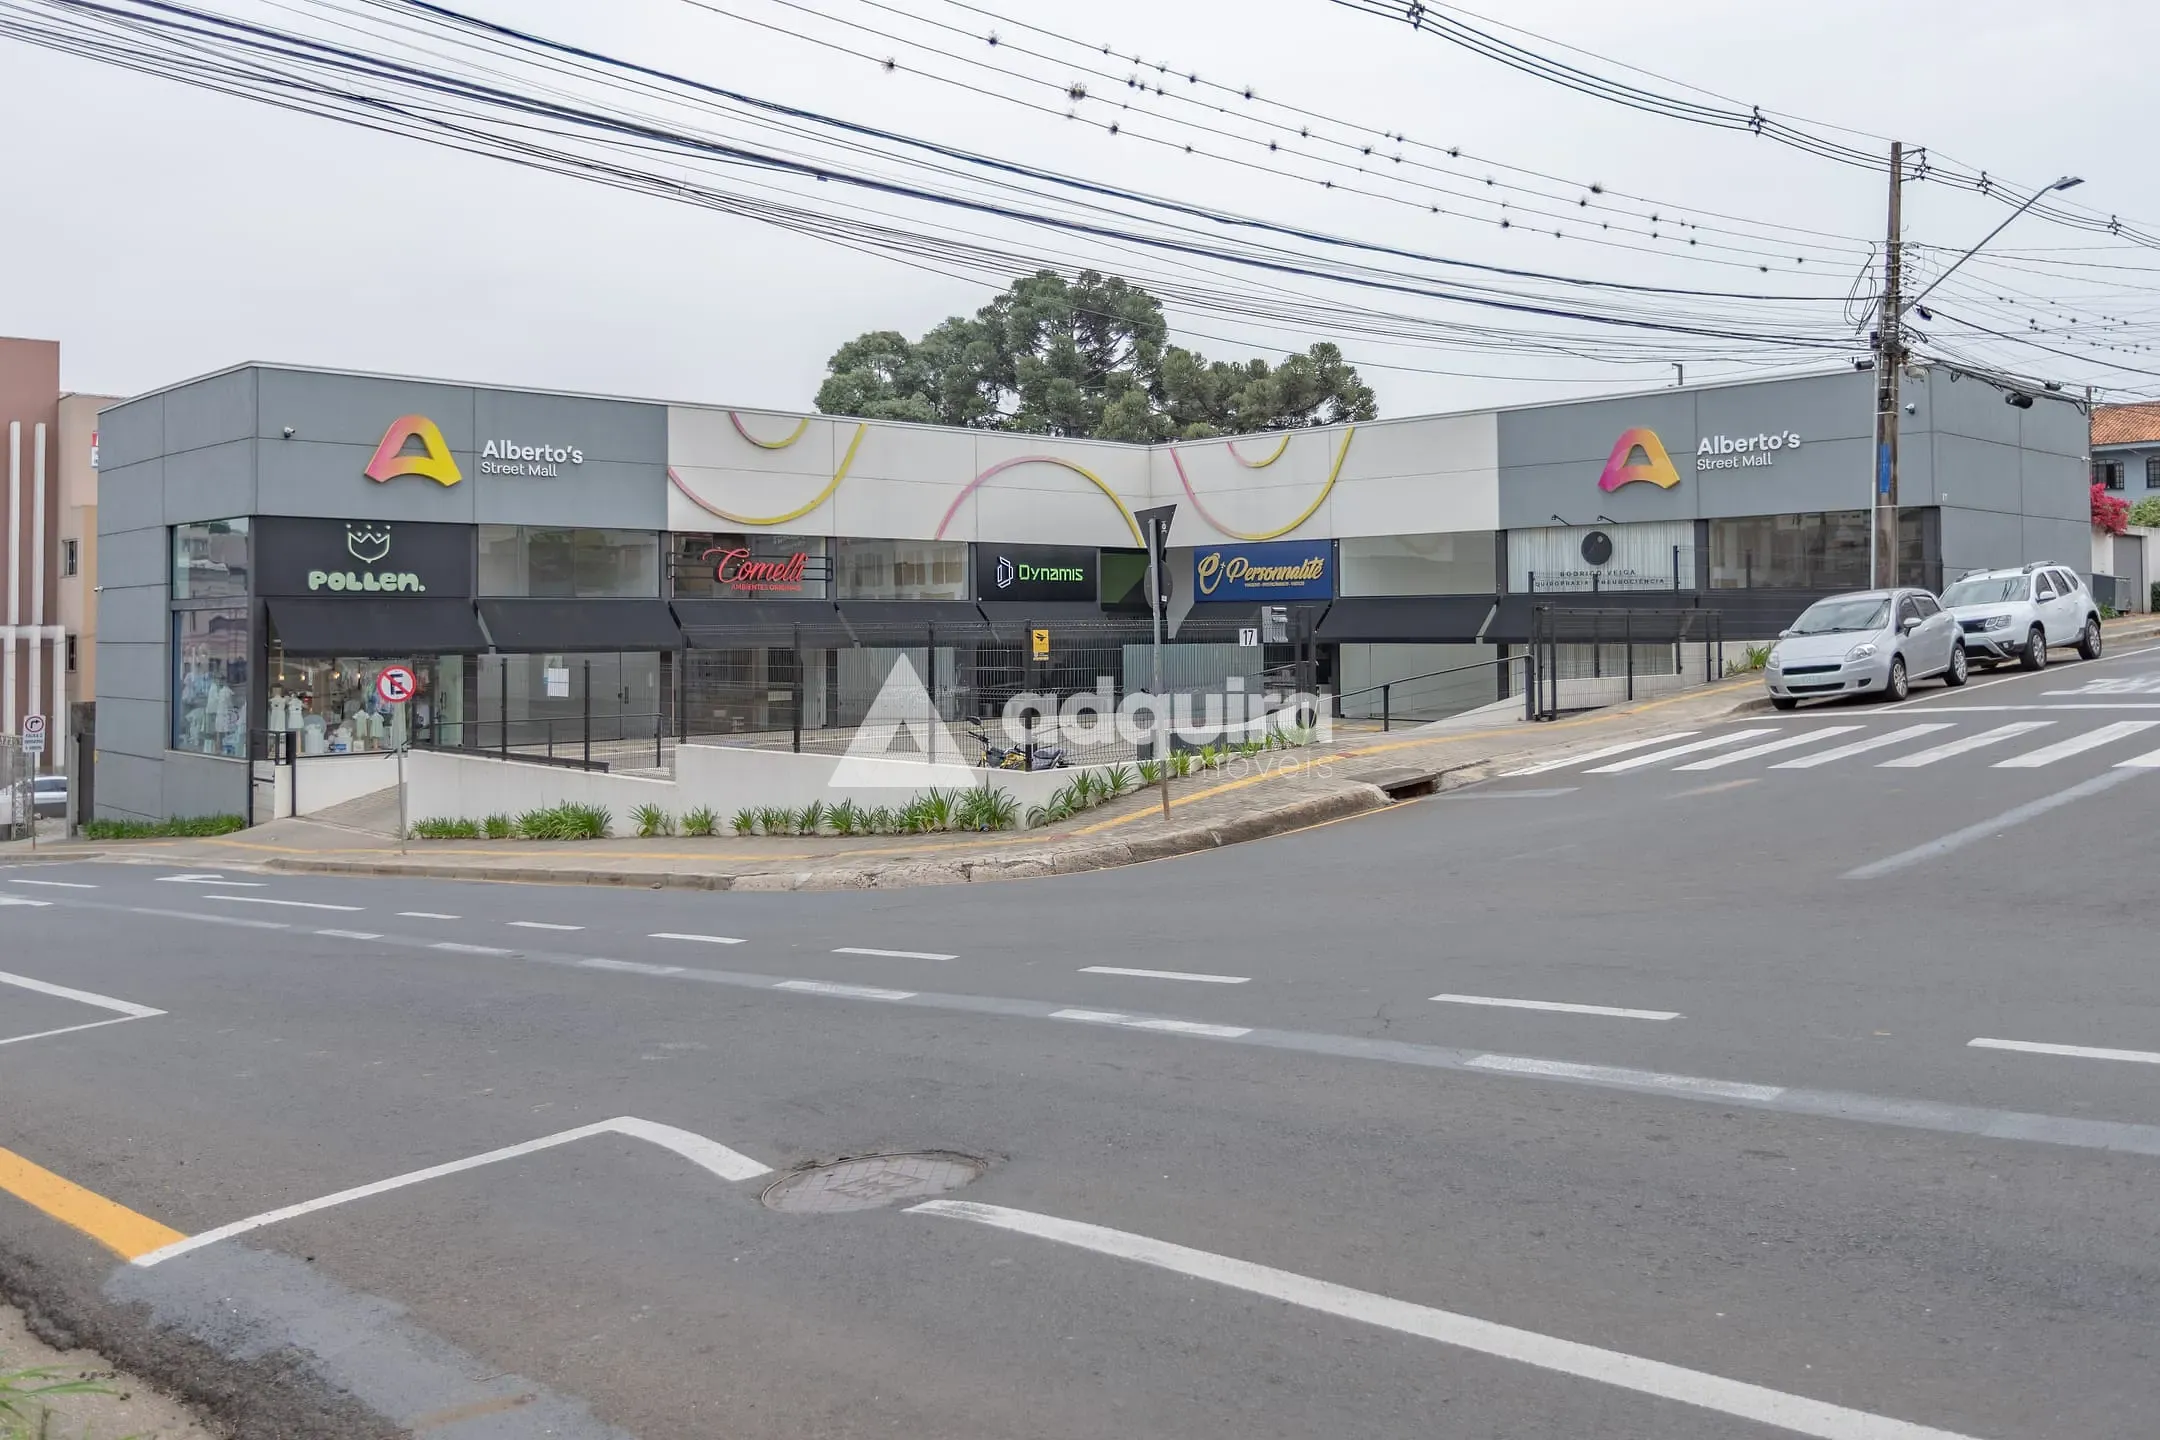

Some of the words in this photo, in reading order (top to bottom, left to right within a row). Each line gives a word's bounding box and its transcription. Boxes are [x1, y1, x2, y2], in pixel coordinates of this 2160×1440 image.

[482, 439, 584, 464] Alberto's
[1696, 430, 1801, 455] Alberto's
[481, 461, 525, 476] Street
[528, 464, 557, 477] Mall
[1696, 457, 1739, 471] Street
[1742, 453, 1773, 467] Mall
[702, 548, 809, 583] Comelli
[1019, 564, 1084, 581] Dynamis
[1242, 629, 1254, 646] 17
[390, 673, 404, 696] E
